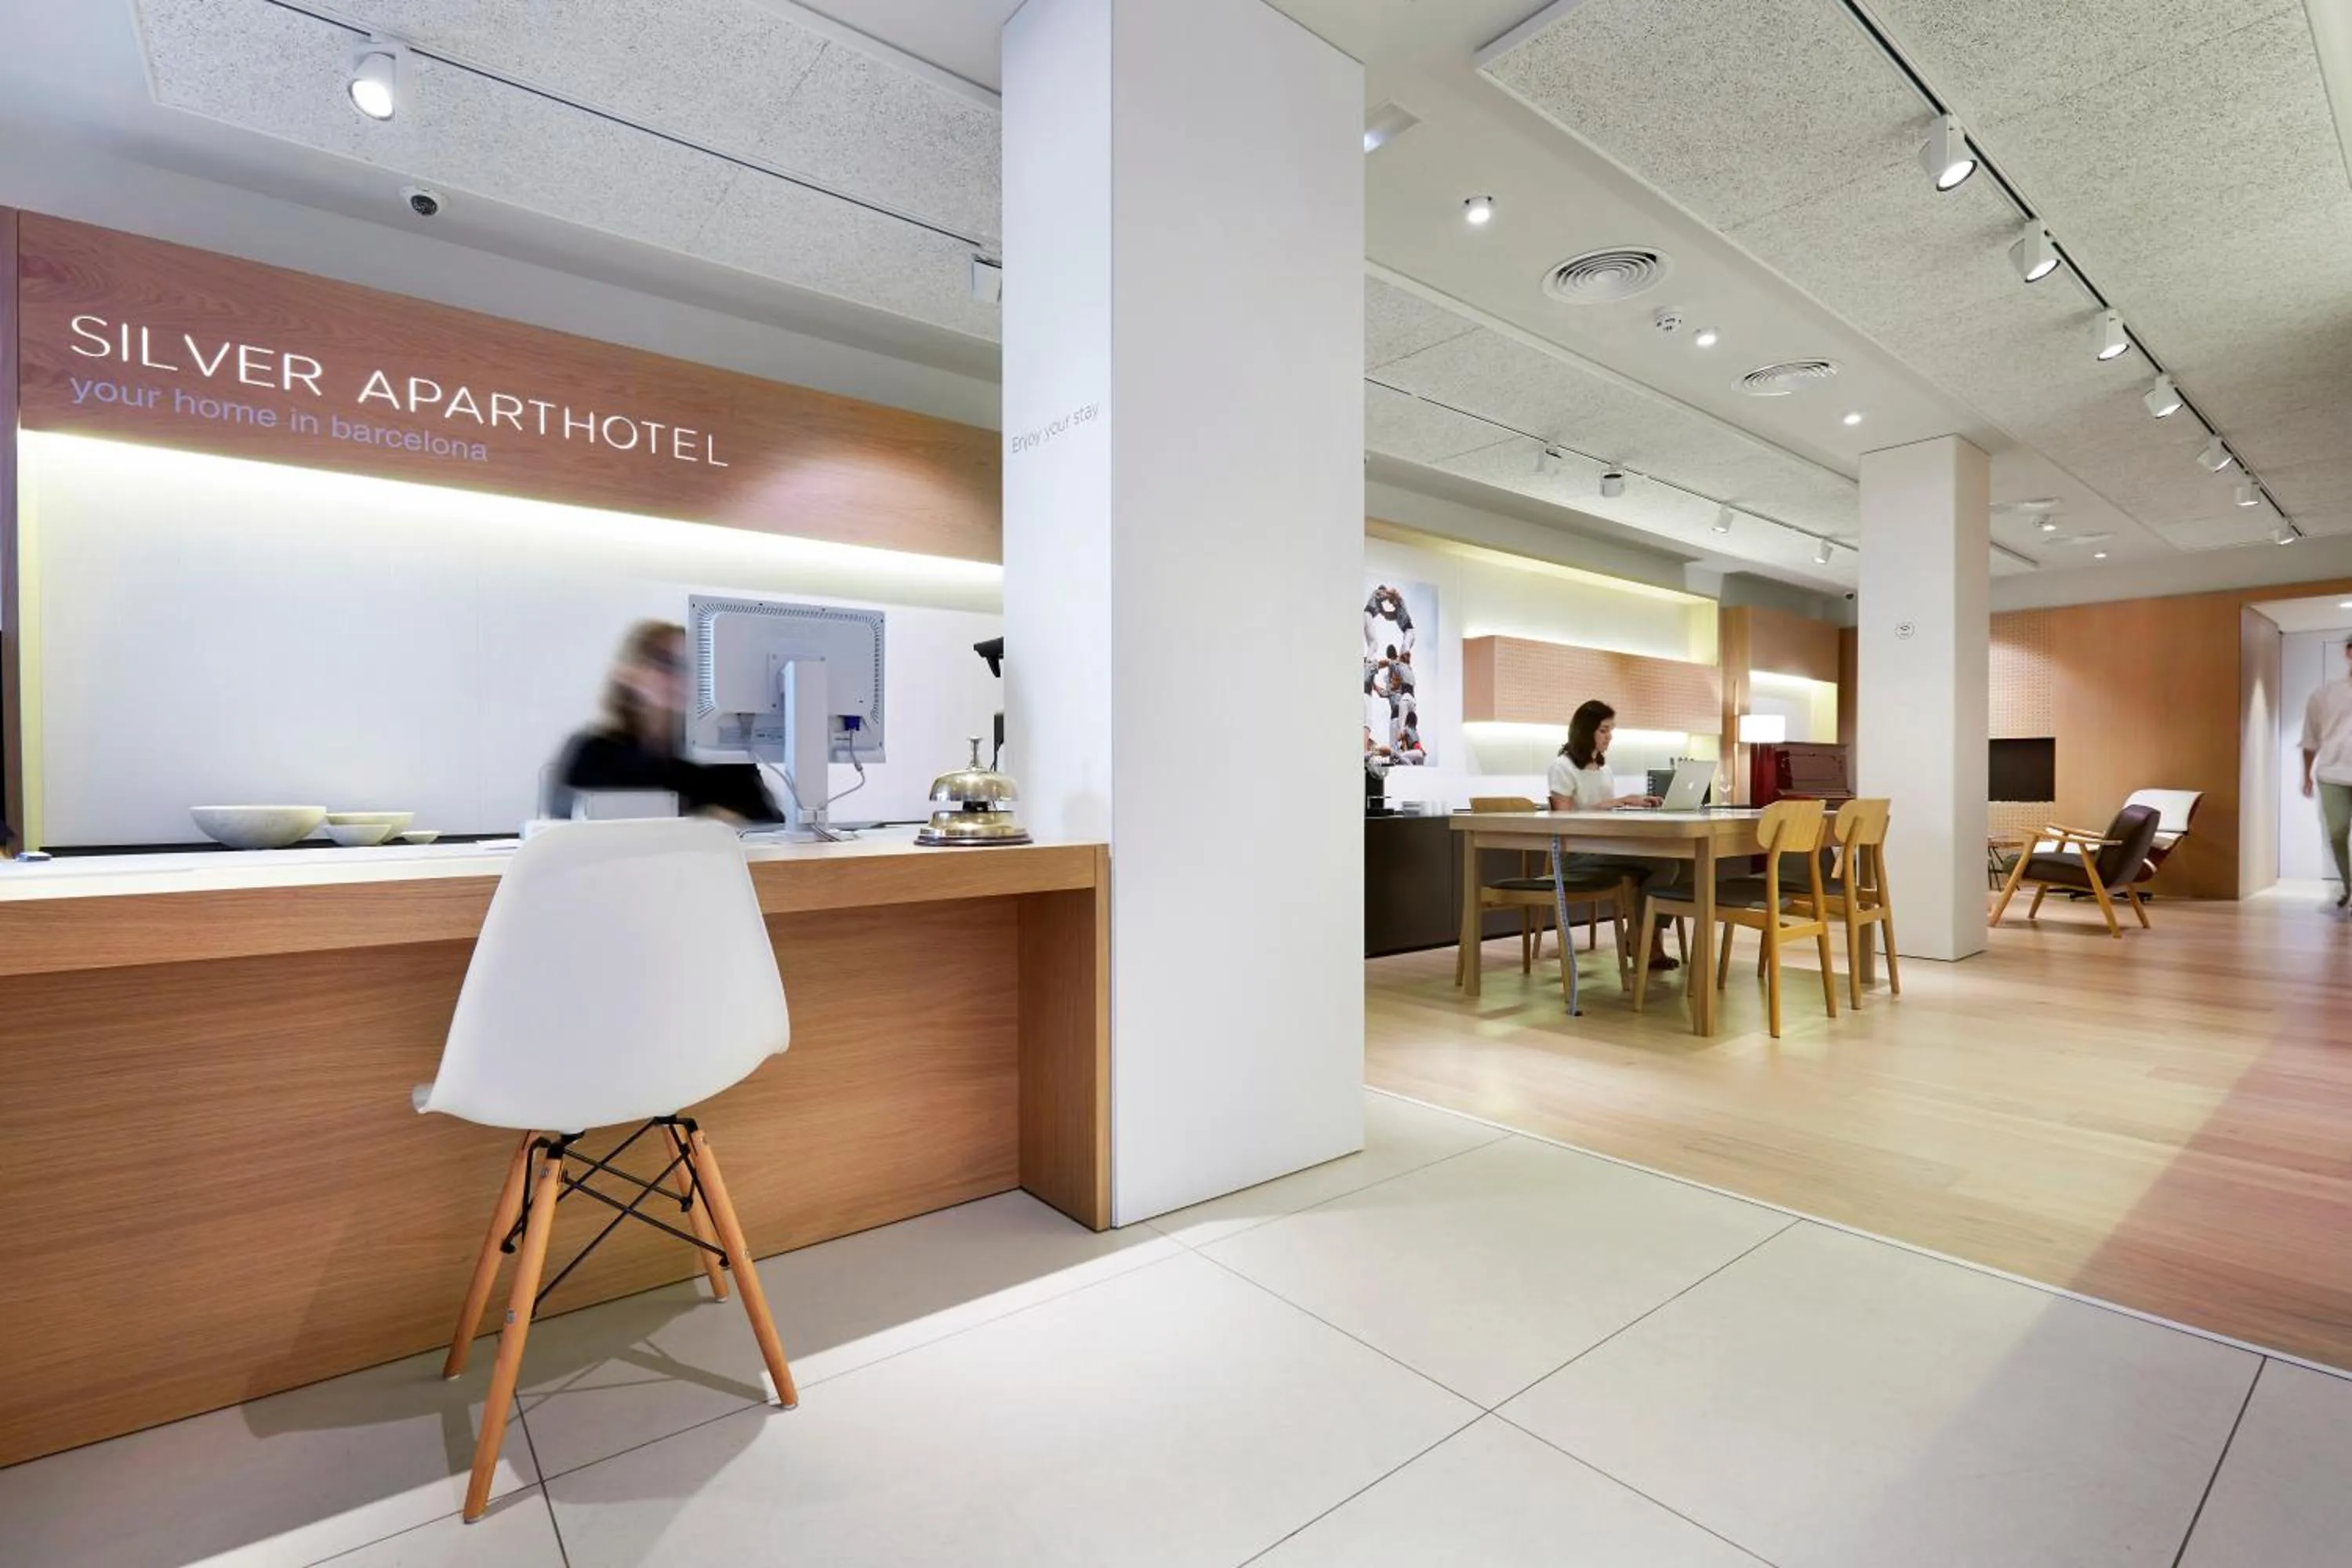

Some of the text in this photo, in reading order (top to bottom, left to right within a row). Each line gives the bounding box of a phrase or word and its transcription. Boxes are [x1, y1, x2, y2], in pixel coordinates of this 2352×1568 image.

[69, 315, 728, 467] SILVER APARTHOTEL
[69, 376, 488, 463] your home in barcelona
[1011, 401, 1099, 453] Enjoy your stay
